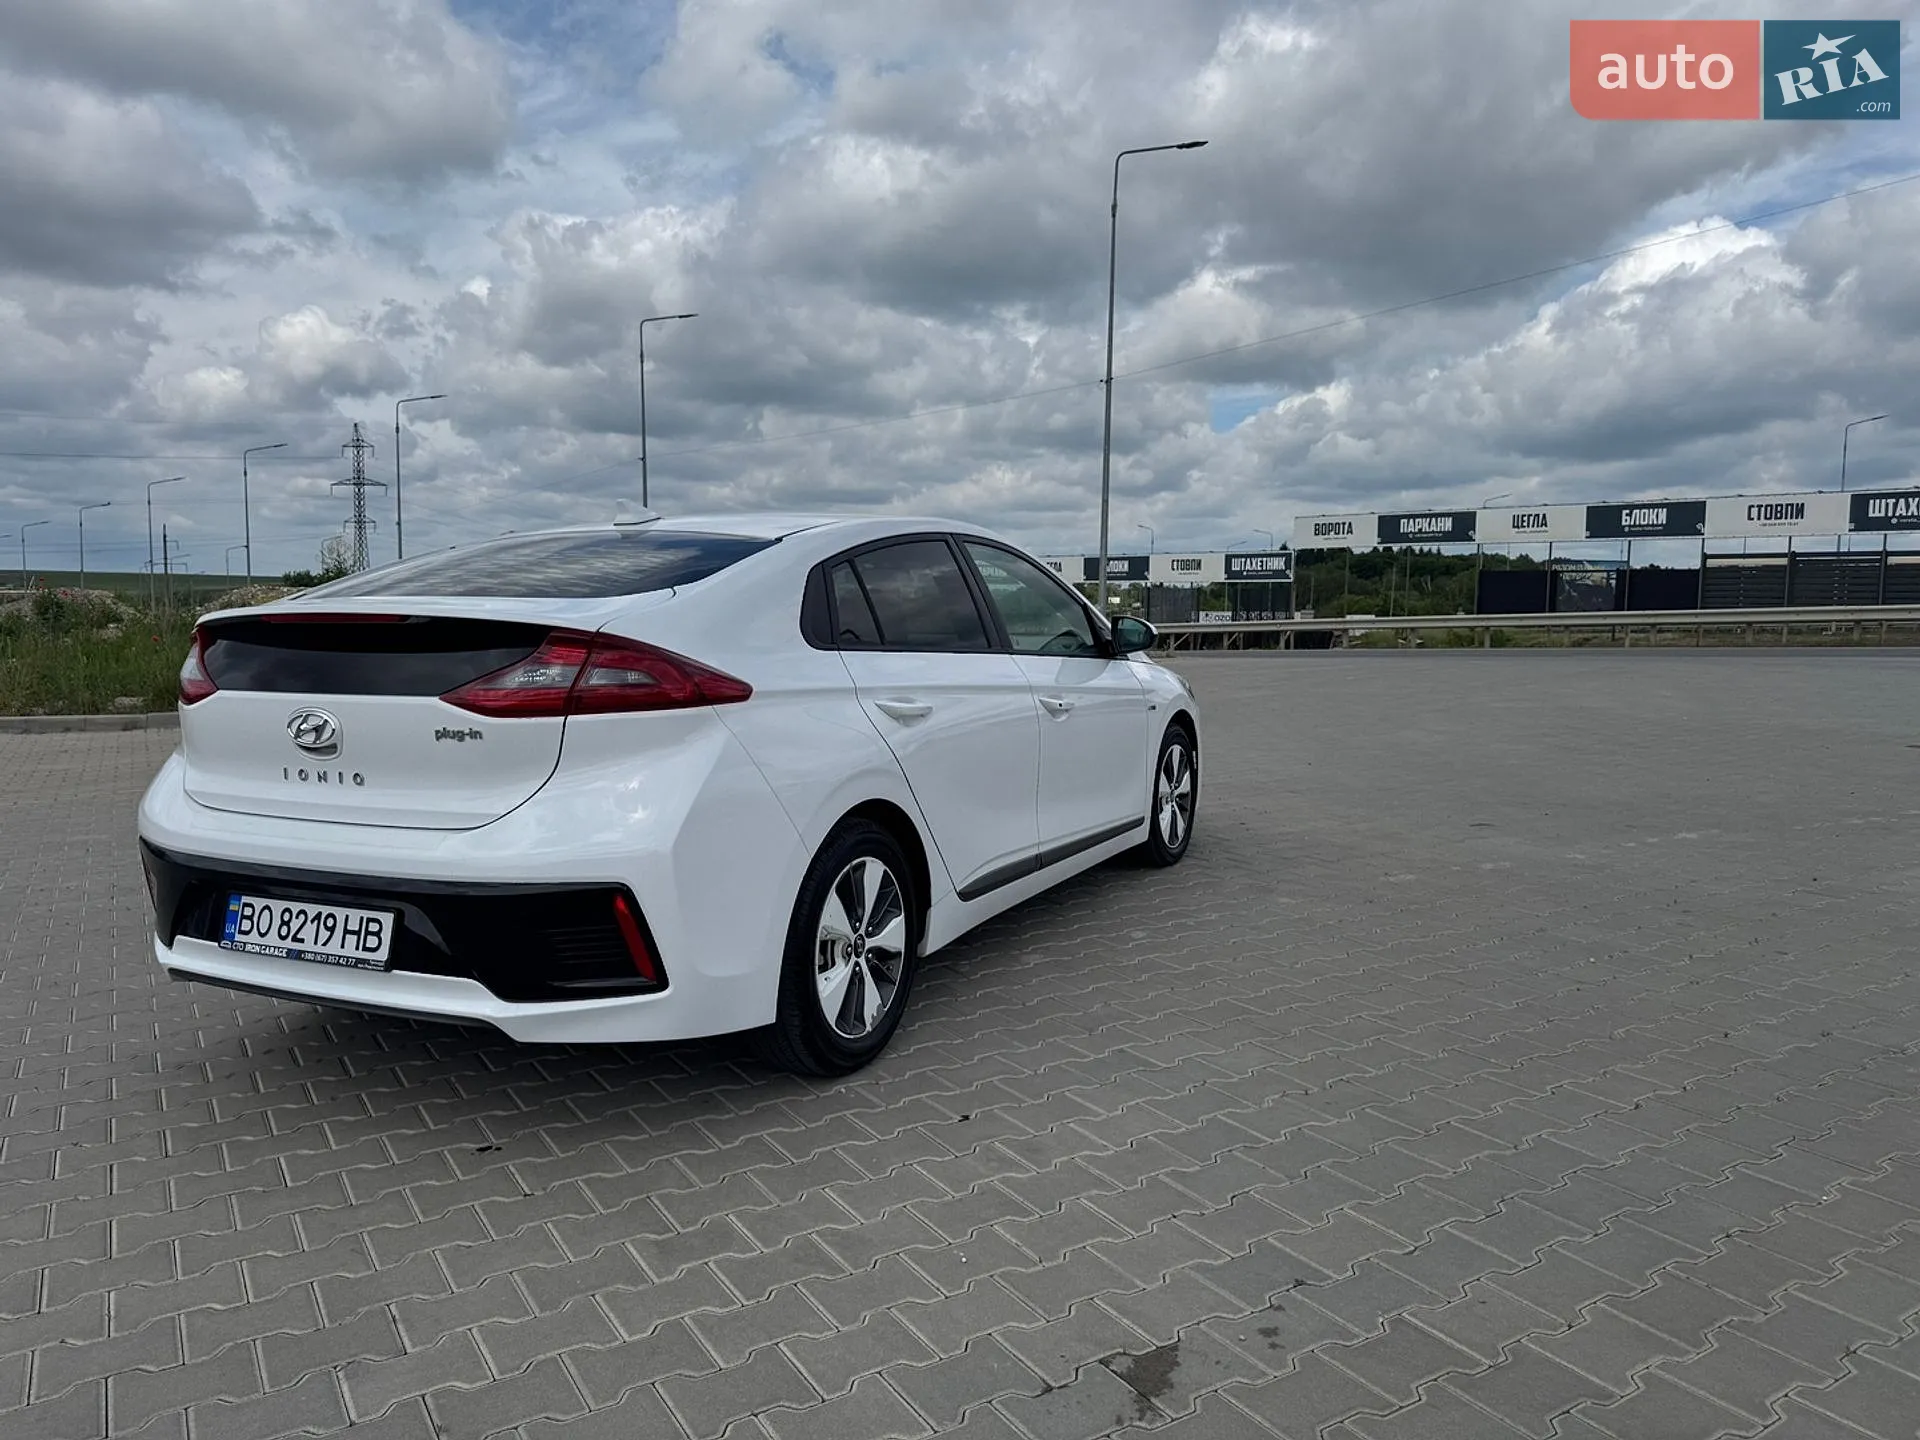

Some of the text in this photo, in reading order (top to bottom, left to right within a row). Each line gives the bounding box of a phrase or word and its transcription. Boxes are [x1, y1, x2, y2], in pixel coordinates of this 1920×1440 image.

[1747, 502, 1805, 521] СТОВПИ
[1868, 497, 1920, 517] ШТАХ
[1400, 517, 1452, 533] ПАРКАНИ
[1512, 513, 1548, 529] ЦЕГЛА
[1621, 508, 1667, 526] БЛОКИ
[1314, 521, 1353, 536] ВОРОТА
[1106, 560, 1129, 572] ЛОКИ
[1171, 558, 1202, 571] СТОВПИ
[1231, 557, 1286, 570] ШТАХЕТНИК
[434, 727, 483, 742] plug-in
[283, 767, 365, 786] IONIQ
[225, 923, 235, 934] UA
[277, 907, 338, 947] 8219
